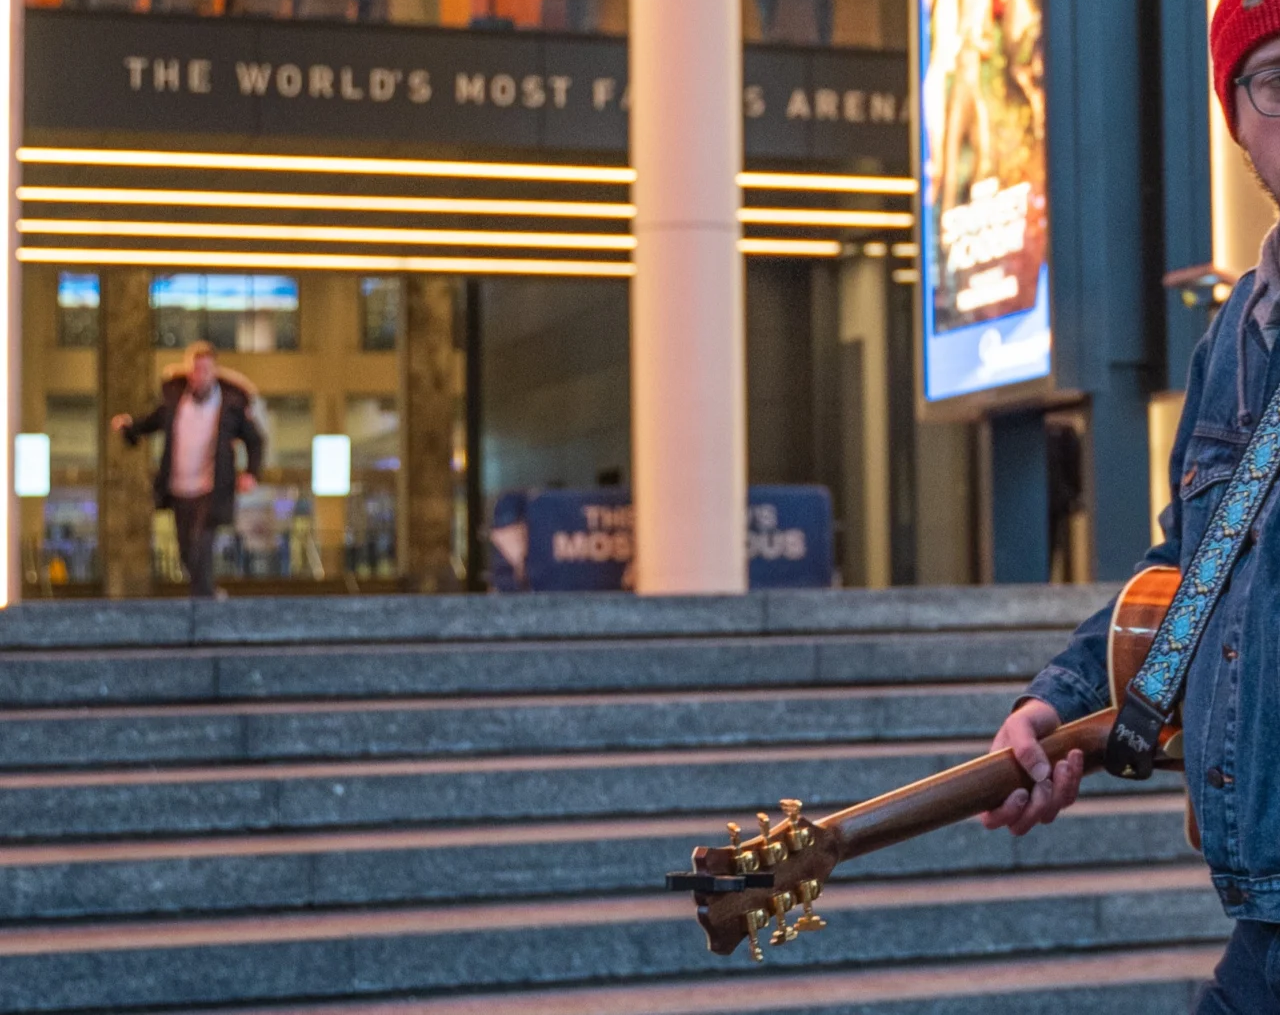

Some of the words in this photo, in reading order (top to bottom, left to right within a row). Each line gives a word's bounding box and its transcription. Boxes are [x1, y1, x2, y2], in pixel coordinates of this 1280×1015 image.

[124, 56, 212, 94] THE
[235, 61, 433, 104] WORLD'S
[455, 72, 572, 109] MOST
